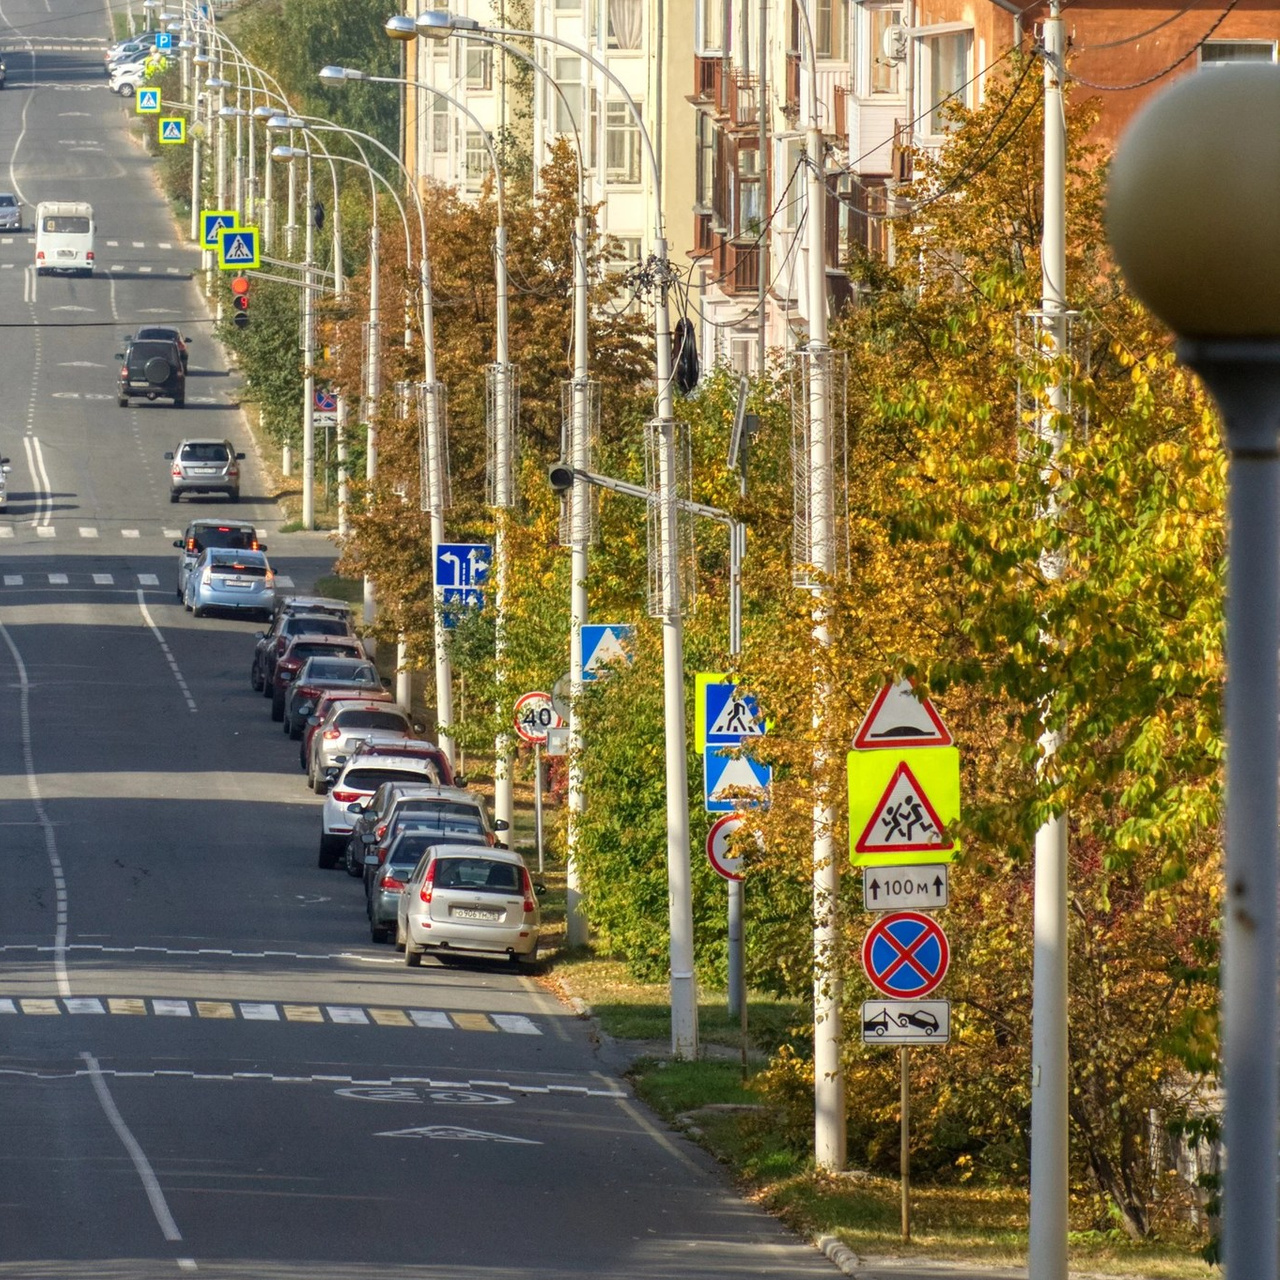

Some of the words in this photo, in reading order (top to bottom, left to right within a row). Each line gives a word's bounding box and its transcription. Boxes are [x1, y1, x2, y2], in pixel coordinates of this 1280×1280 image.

[160, 35, 169, 47] P
[241, 296, 248, 309] 9
[523, 708, 552, 727] 40
